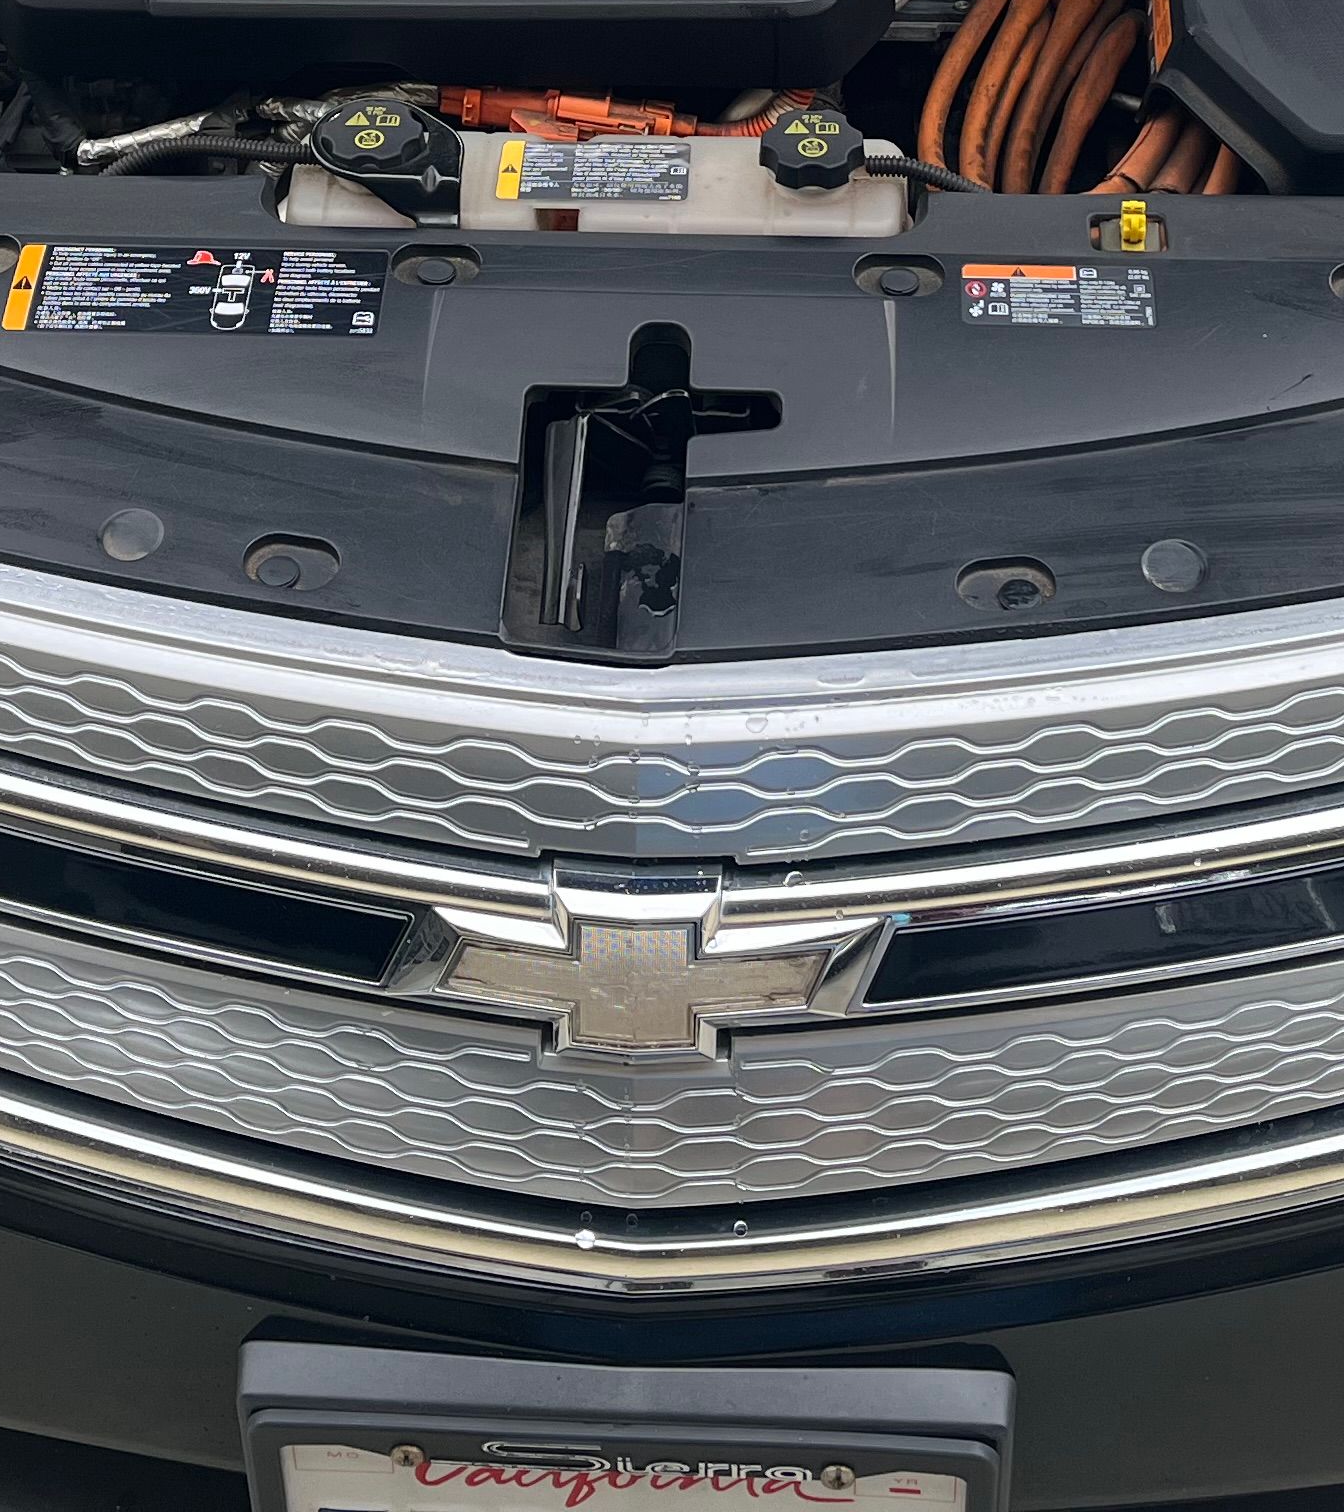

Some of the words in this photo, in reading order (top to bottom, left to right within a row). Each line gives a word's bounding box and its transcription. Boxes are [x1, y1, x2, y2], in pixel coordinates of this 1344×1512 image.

[233, 251, 252, 261] 12V
[326, 1450, 360, 1460] MO
[430, 1441, 814, 1482] Sierra
